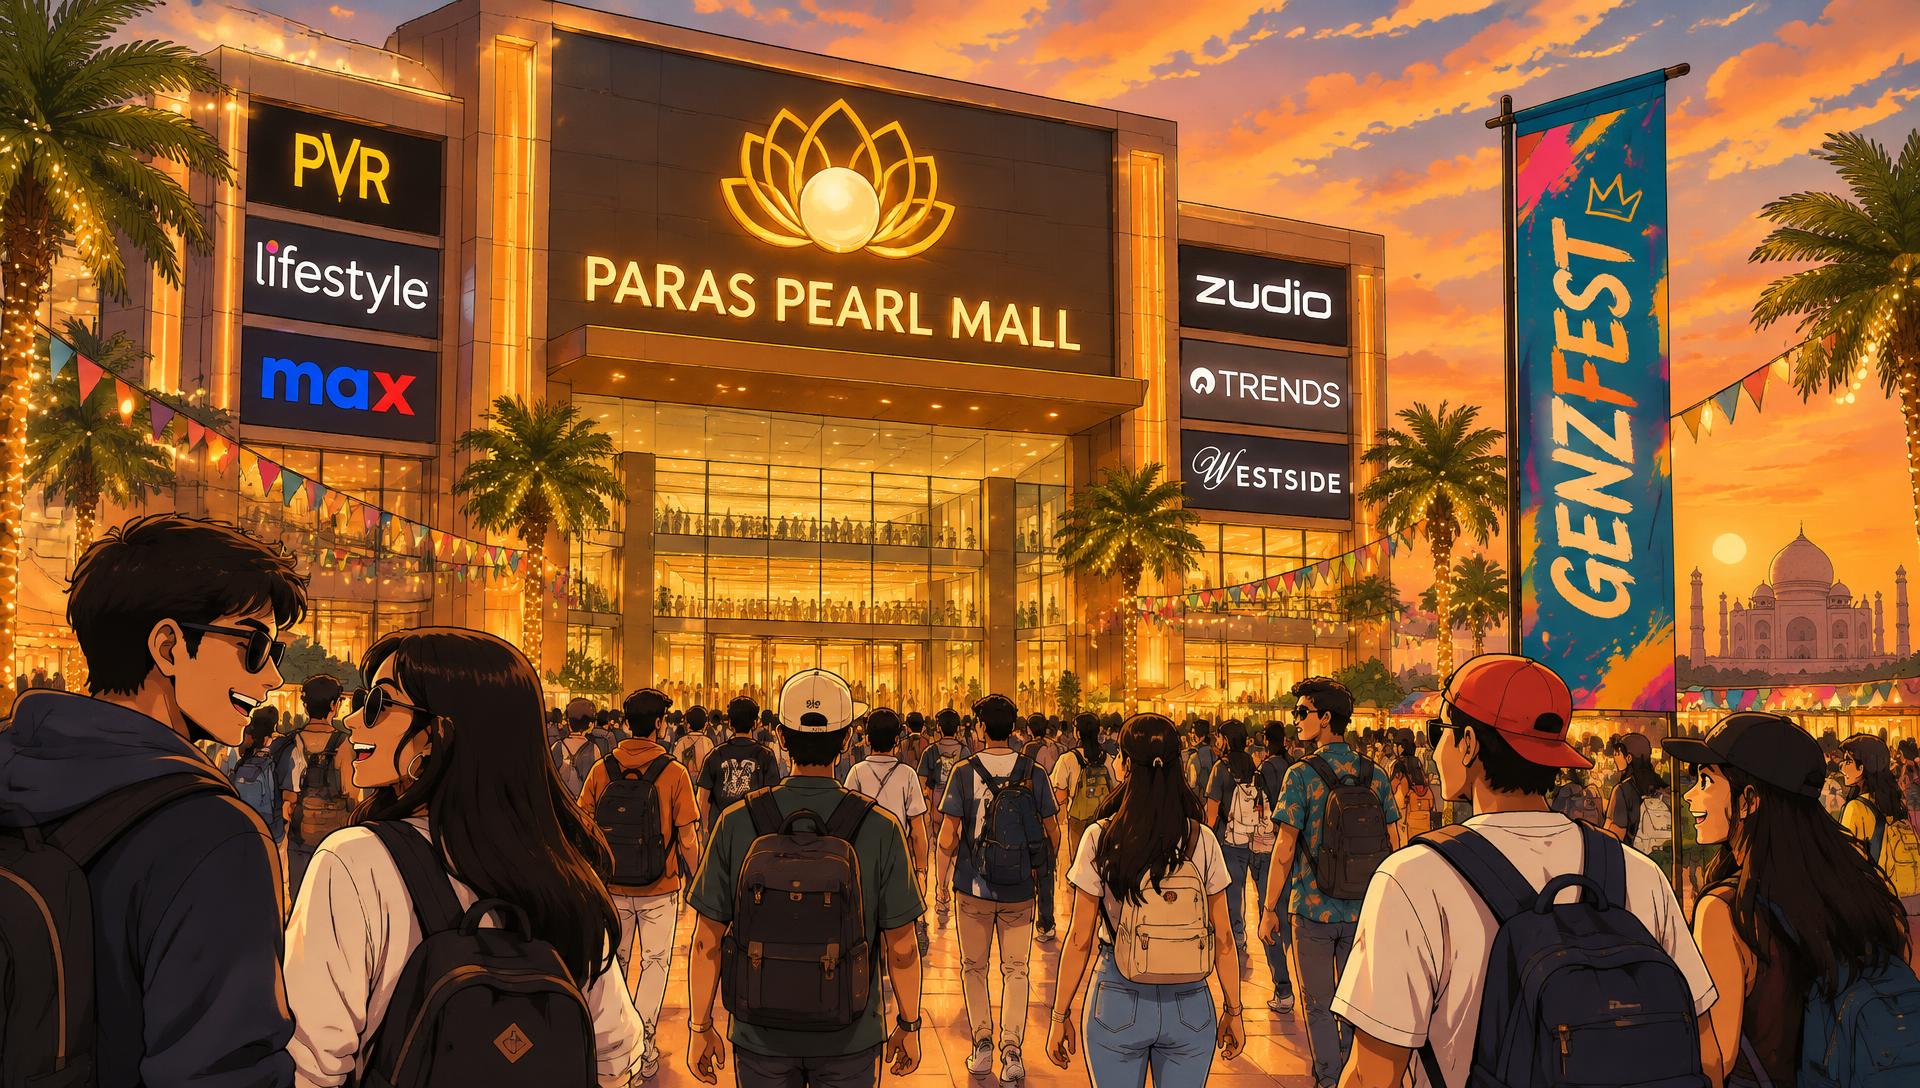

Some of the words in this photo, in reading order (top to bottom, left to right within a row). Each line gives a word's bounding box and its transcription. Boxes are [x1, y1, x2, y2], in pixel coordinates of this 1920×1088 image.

[293, 132, 390, 205] PVR
[256, 239, 429, 315] lifestyle
[585, 255, 757, 318] PARAS
[776, 276, 933, 336] PEARL
[951, 296, 1081, 351] MALL
[1195, 274, 1332, 320] zudio
[261, 356, 417, 416] max
[1218, 369, 1341, 408] TRENDS
[1550, 216, 1638, 620] GENZFEST
[1191, 445, 1342, 494] WESTSIDE
